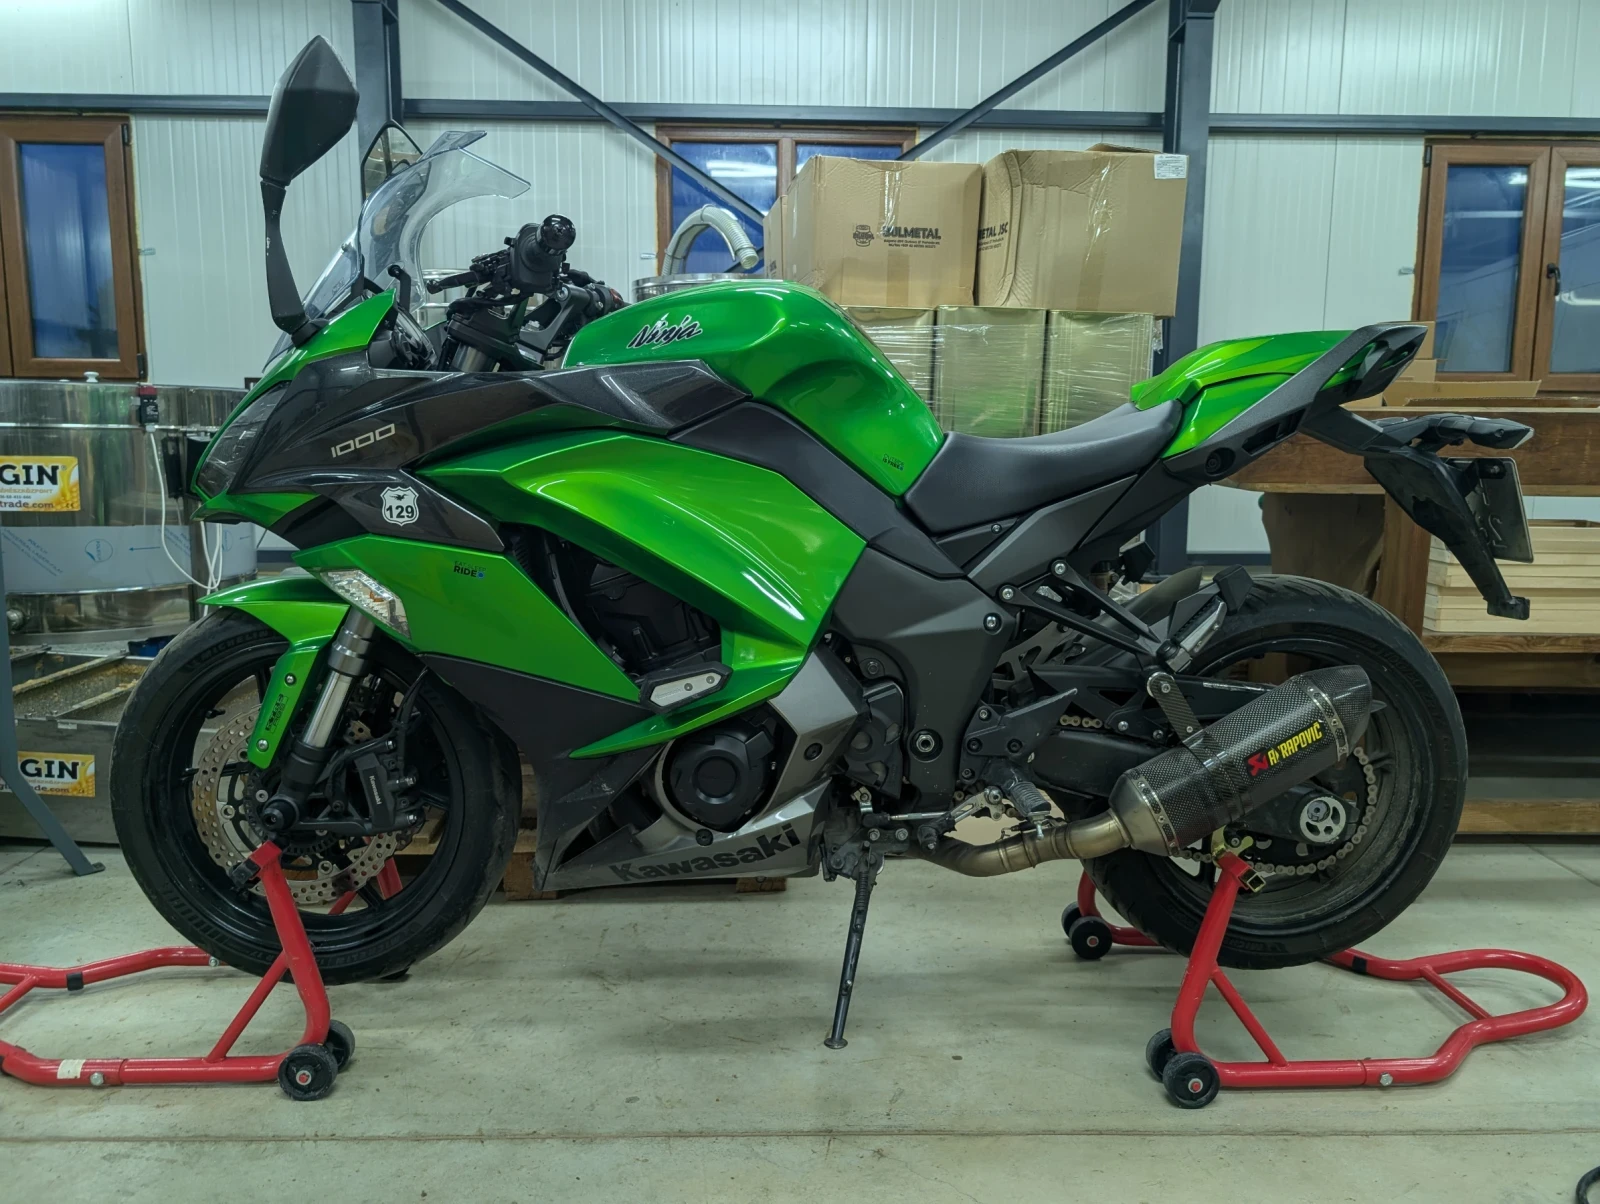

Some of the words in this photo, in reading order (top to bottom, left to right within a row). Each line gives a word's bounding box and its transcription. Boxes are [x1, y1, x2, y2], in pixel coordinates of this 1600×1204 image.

[626, 313, 703, 349] Ninja
[330, 423, 396, 458] 1000
[0, 463, 59, 486] GIN
[386, 505, 415, 519] 129
[453, 565, 478, 578] RIDE
[201, 628, 269, 660] MICHELIN
[20, 758, 79, 780] GIN
[369, 775, 383, 805] Kawasaki
[609, 823, 801, 882] Kawasaki
